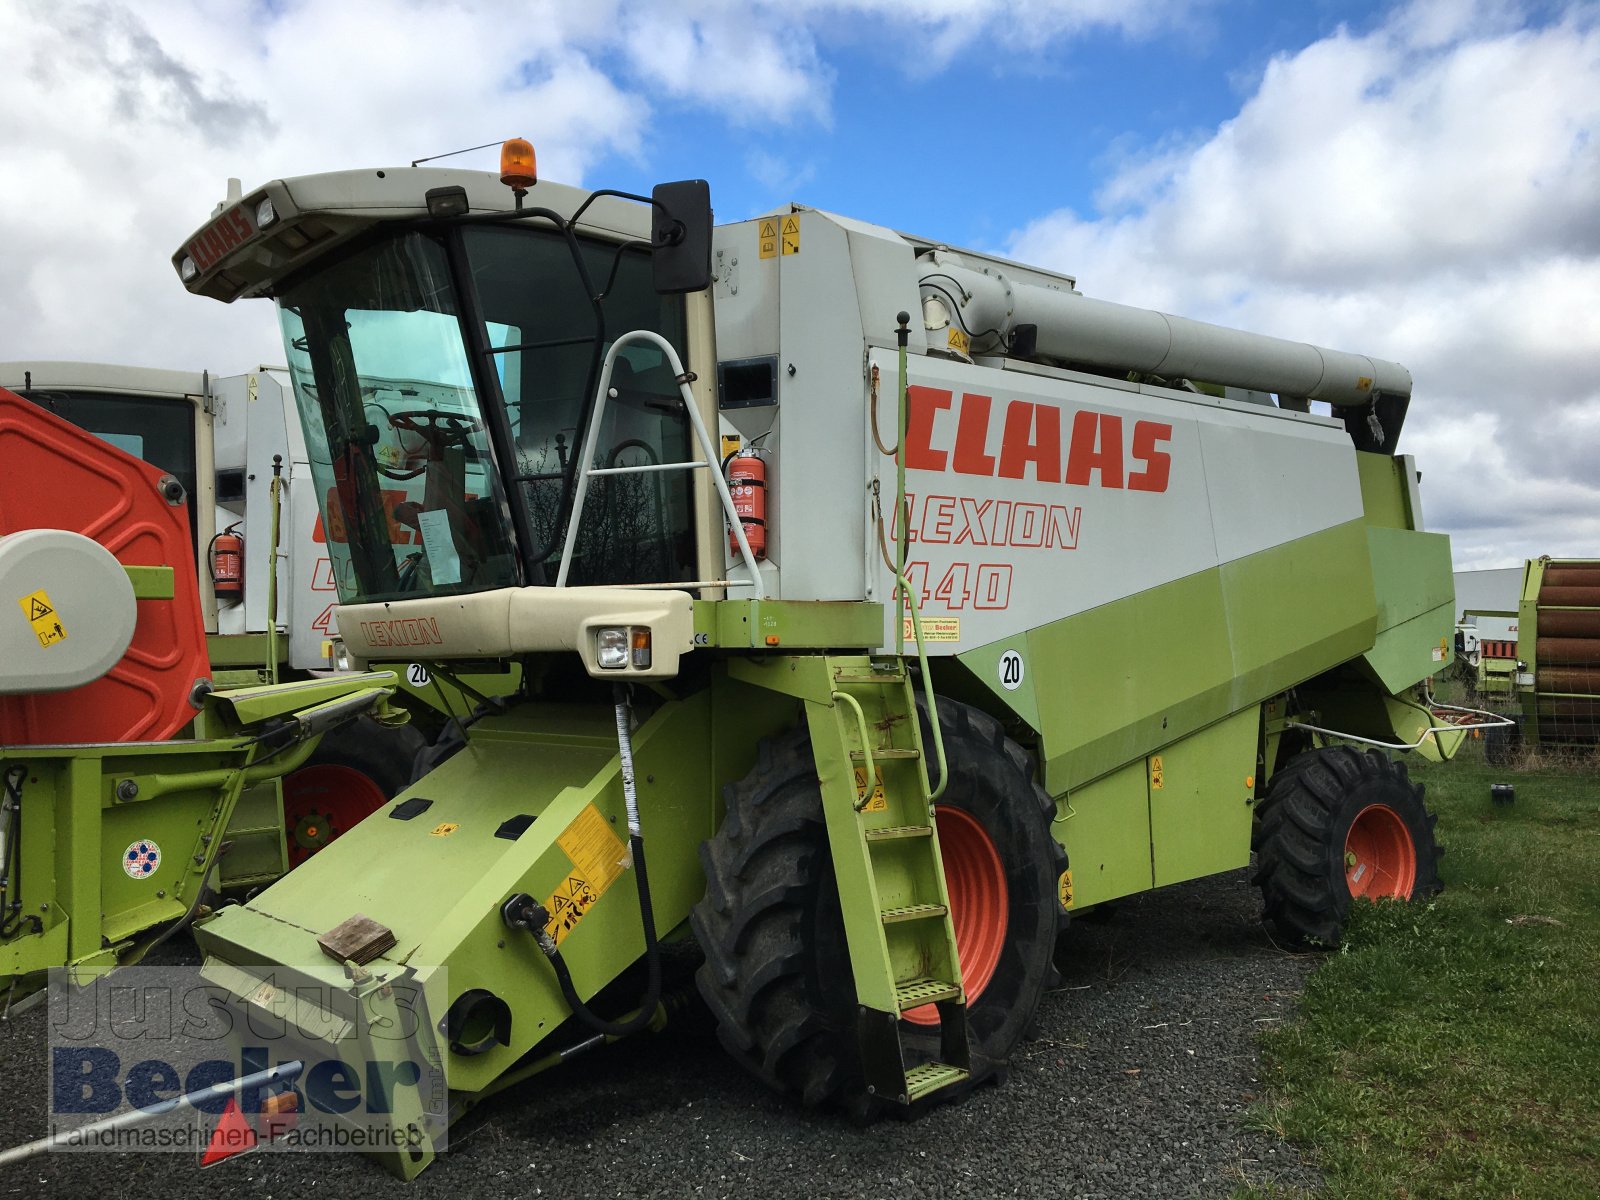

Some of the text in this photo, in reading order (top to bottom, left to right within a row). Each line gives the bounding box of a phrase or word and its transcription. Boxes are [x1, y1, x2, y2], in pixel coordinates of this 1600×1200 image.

[187, 206, 254, 271] CLAAS
[895, 384, 1173, 493] CLAAS
[890, 493, 1082, 550] LEXION
[892, 561, 1013, 610] 440
[360, 616, 443, 647] LEXION
[411, 664, 428, 683] 20
[1003, 656, 1020, 684] 20
